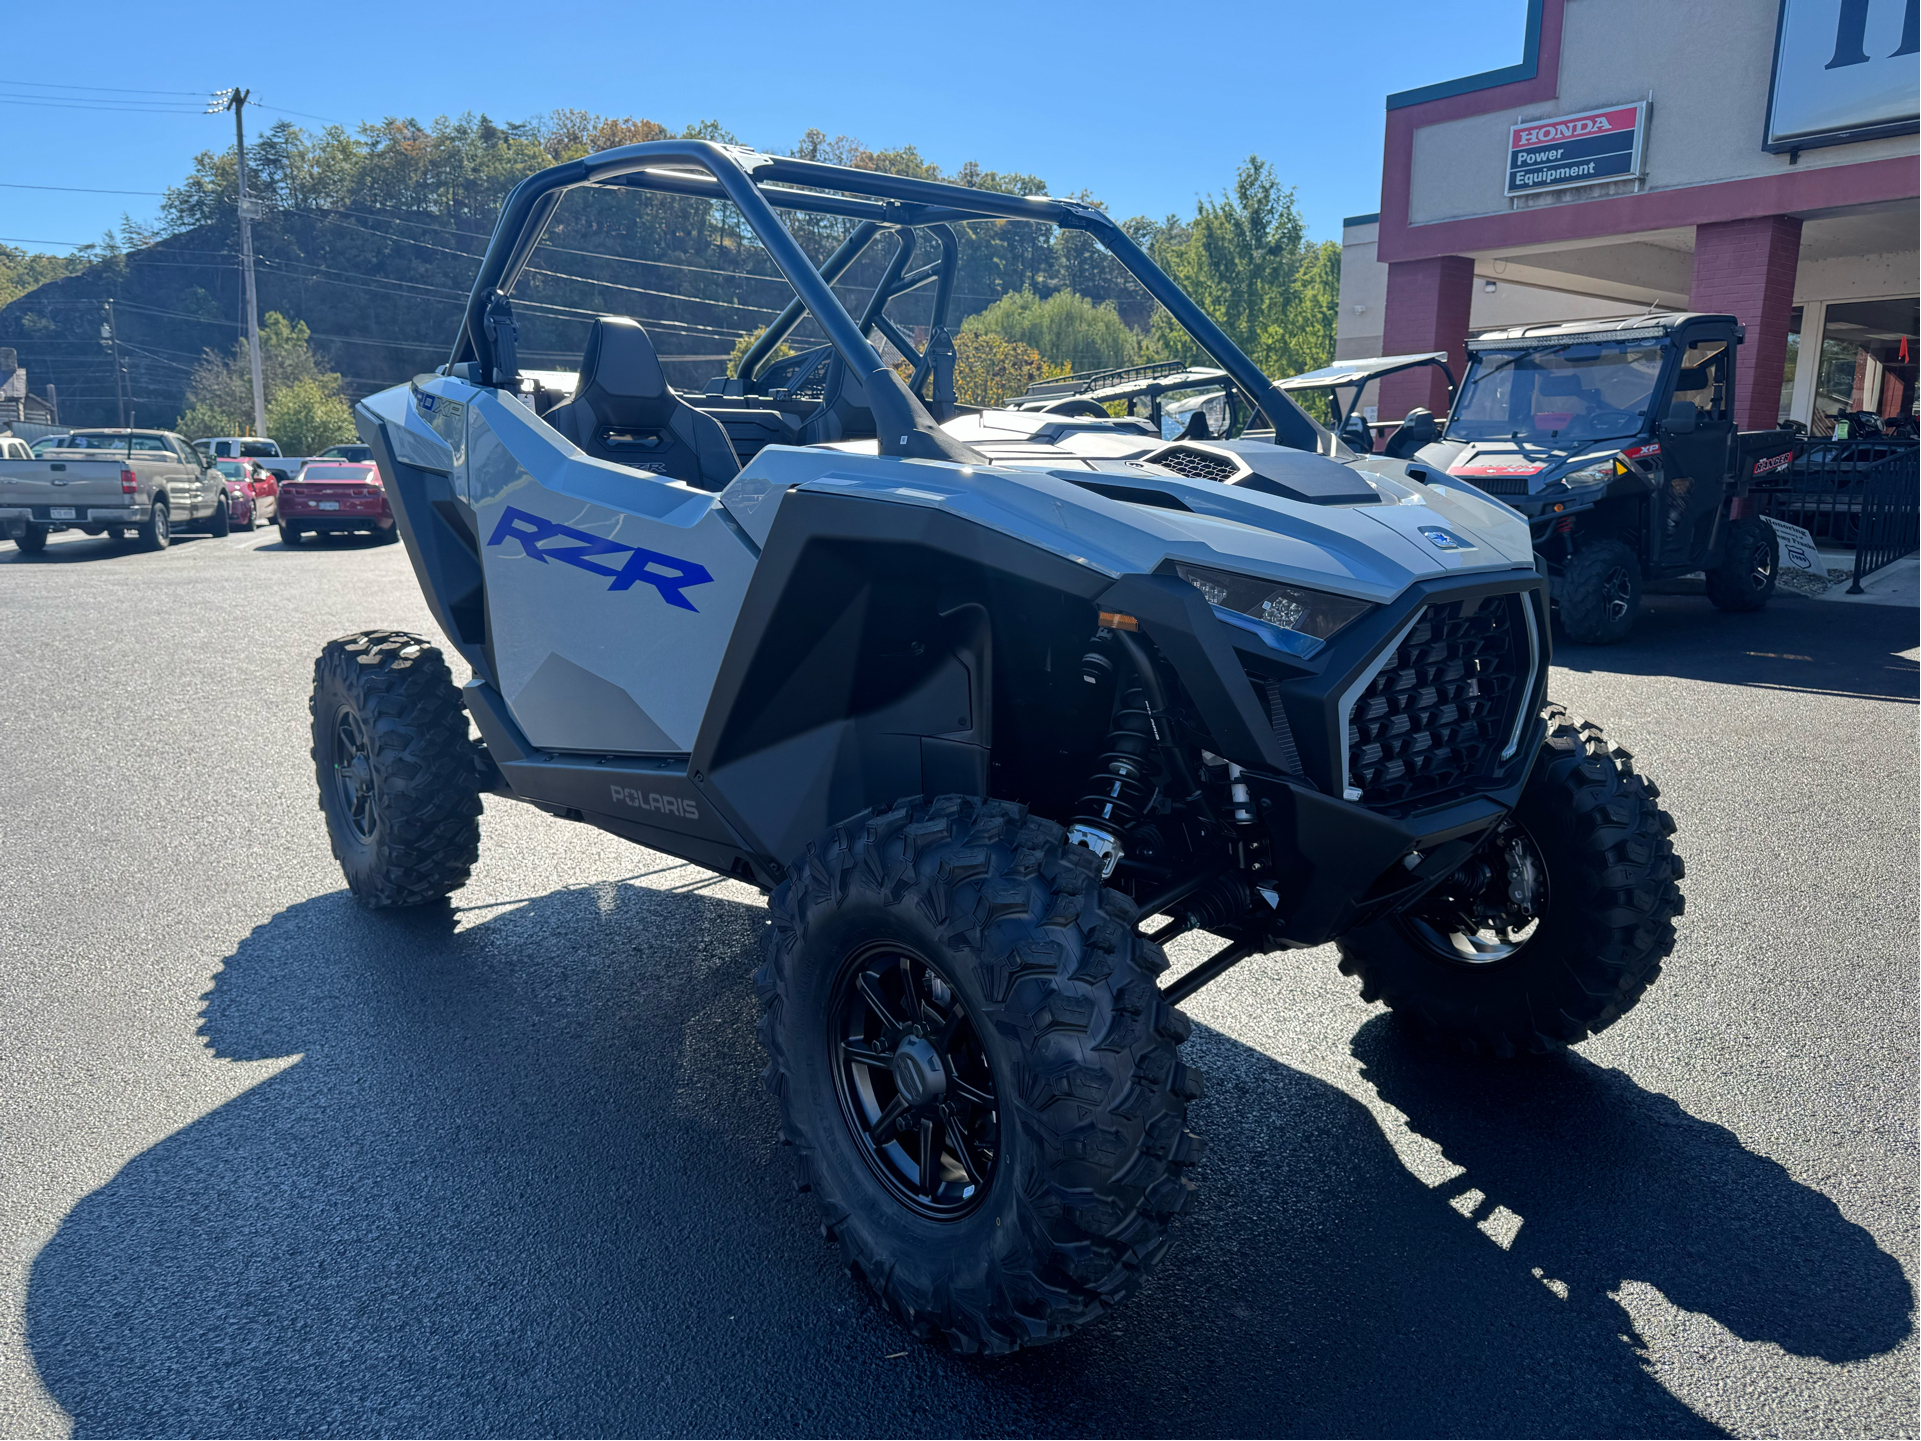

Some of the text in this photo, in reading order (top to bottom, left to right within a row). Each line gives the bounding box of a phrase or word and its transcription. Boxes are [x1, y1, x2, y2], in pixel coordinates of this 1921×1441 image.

[1519, 116, 1612, 145] HONDA
[1517, 148, 1564, 166] Power
[1515, 161, 1596, 186] Equipment
[1640, 444, 1659, 454] XP
[1754, 452, 1791, 474] RANGER
[486, 505, 715, 613] RZR
[610, 784, 699, 820] POLARIS
